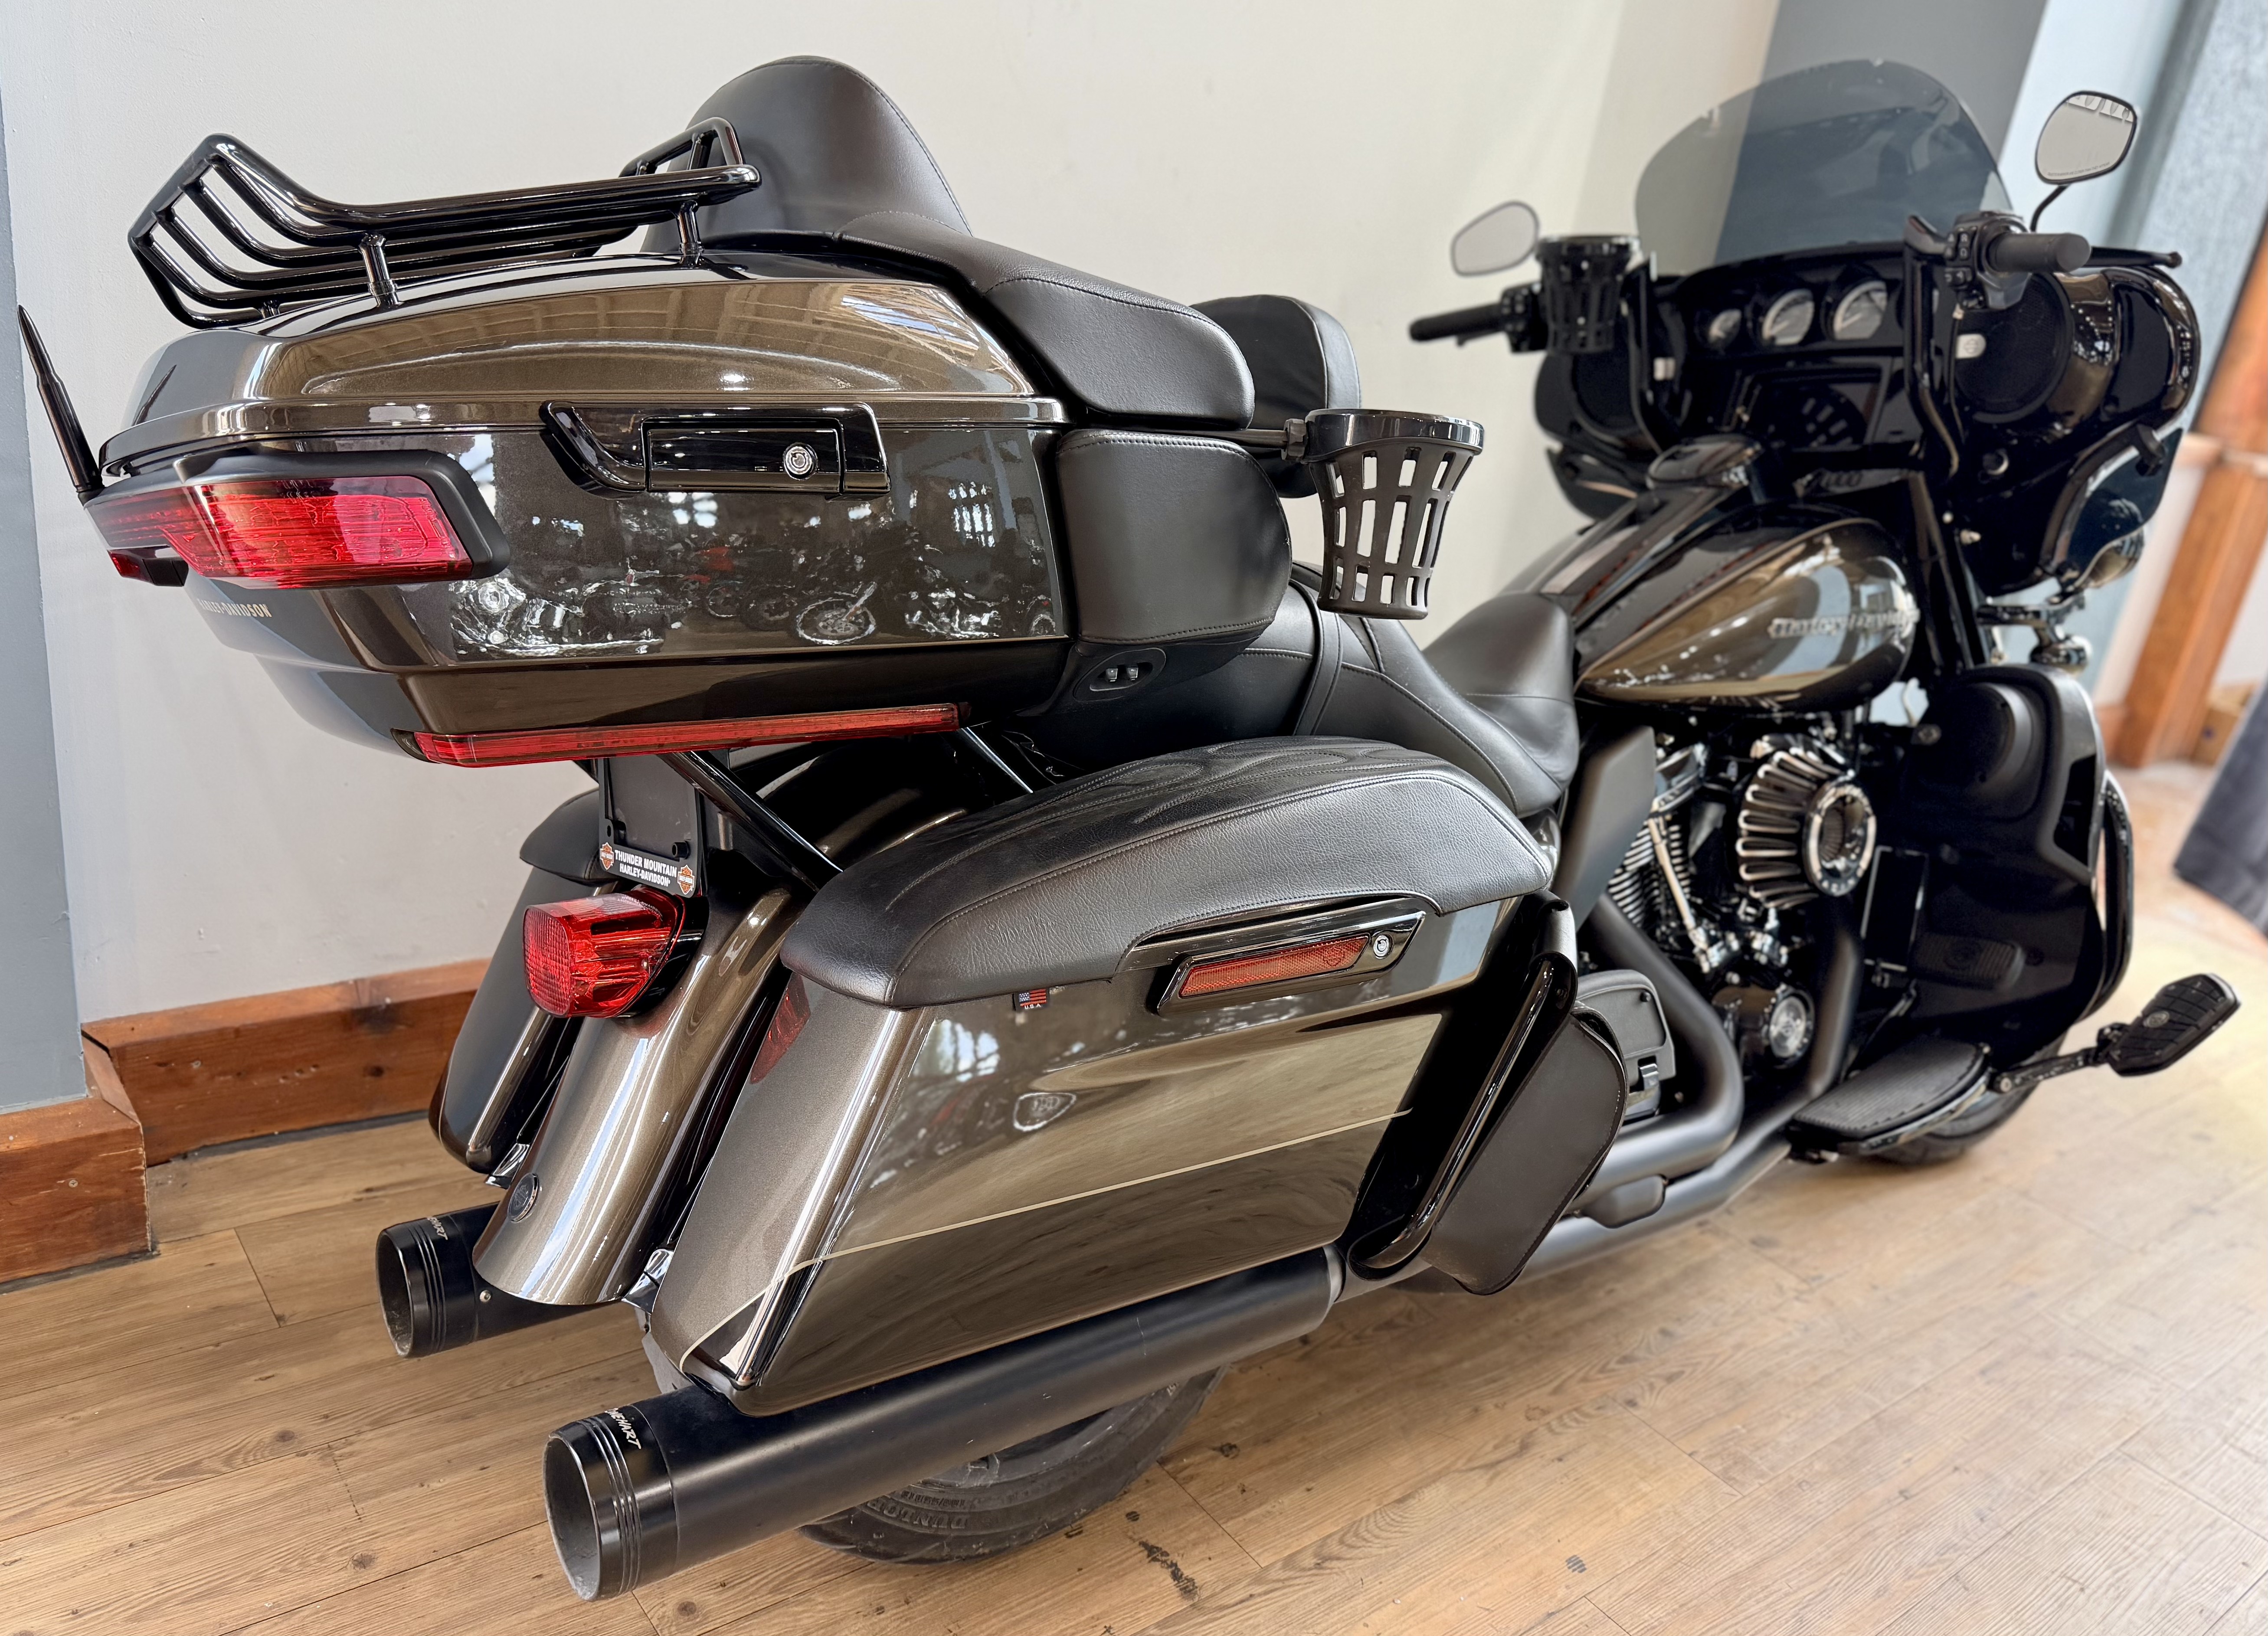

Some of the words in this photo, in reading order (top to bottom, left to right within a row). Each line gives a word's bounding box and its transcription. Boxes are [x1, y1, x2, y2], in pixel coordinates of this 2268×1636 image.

[615, 850, 643, 867] THUNDER
[644, 858, 677, 878] MOUNTAIN
[619, 863, 669, 887] HARLEY-DAVIDSON
